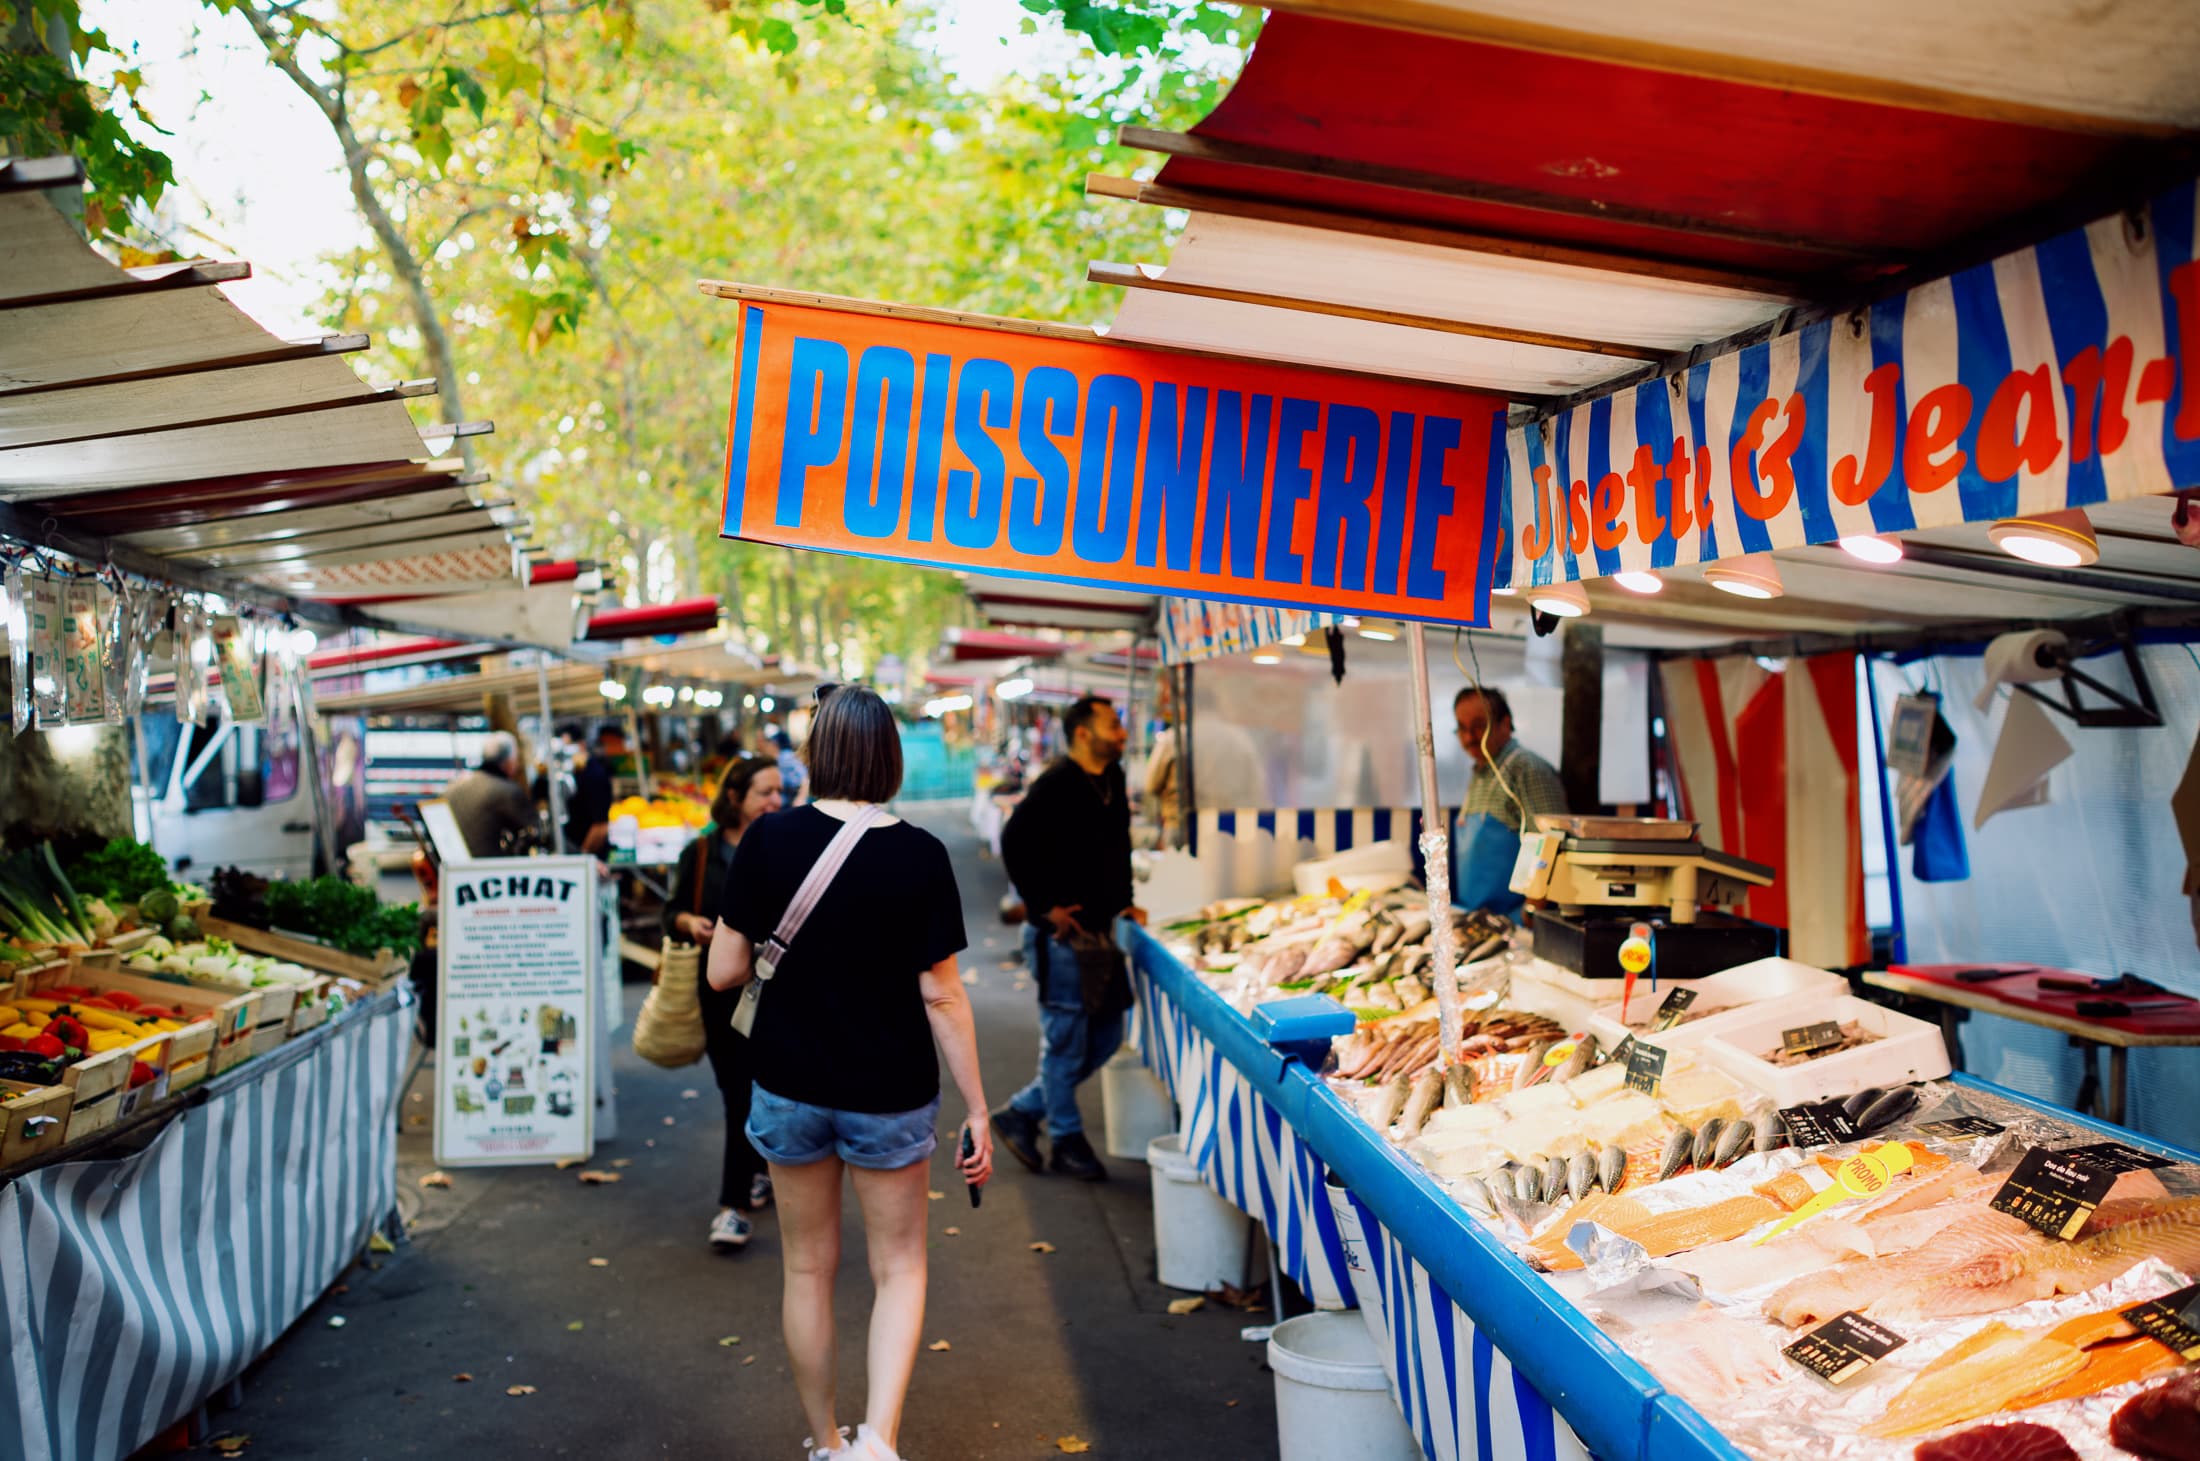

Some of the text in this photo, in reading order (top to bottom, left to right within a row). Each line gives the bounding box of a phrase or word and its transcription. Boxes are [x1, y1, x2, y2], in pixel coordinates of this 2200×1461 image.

[775, 336, 1462, 601] POISSONNERIE
[1522, 436, 1714, 560] Josette
[1731, 391, 1807, 521] &
[456, 876, 577, 907] ACHAT
[1846, 1158, 1882, 1193] PROMO
